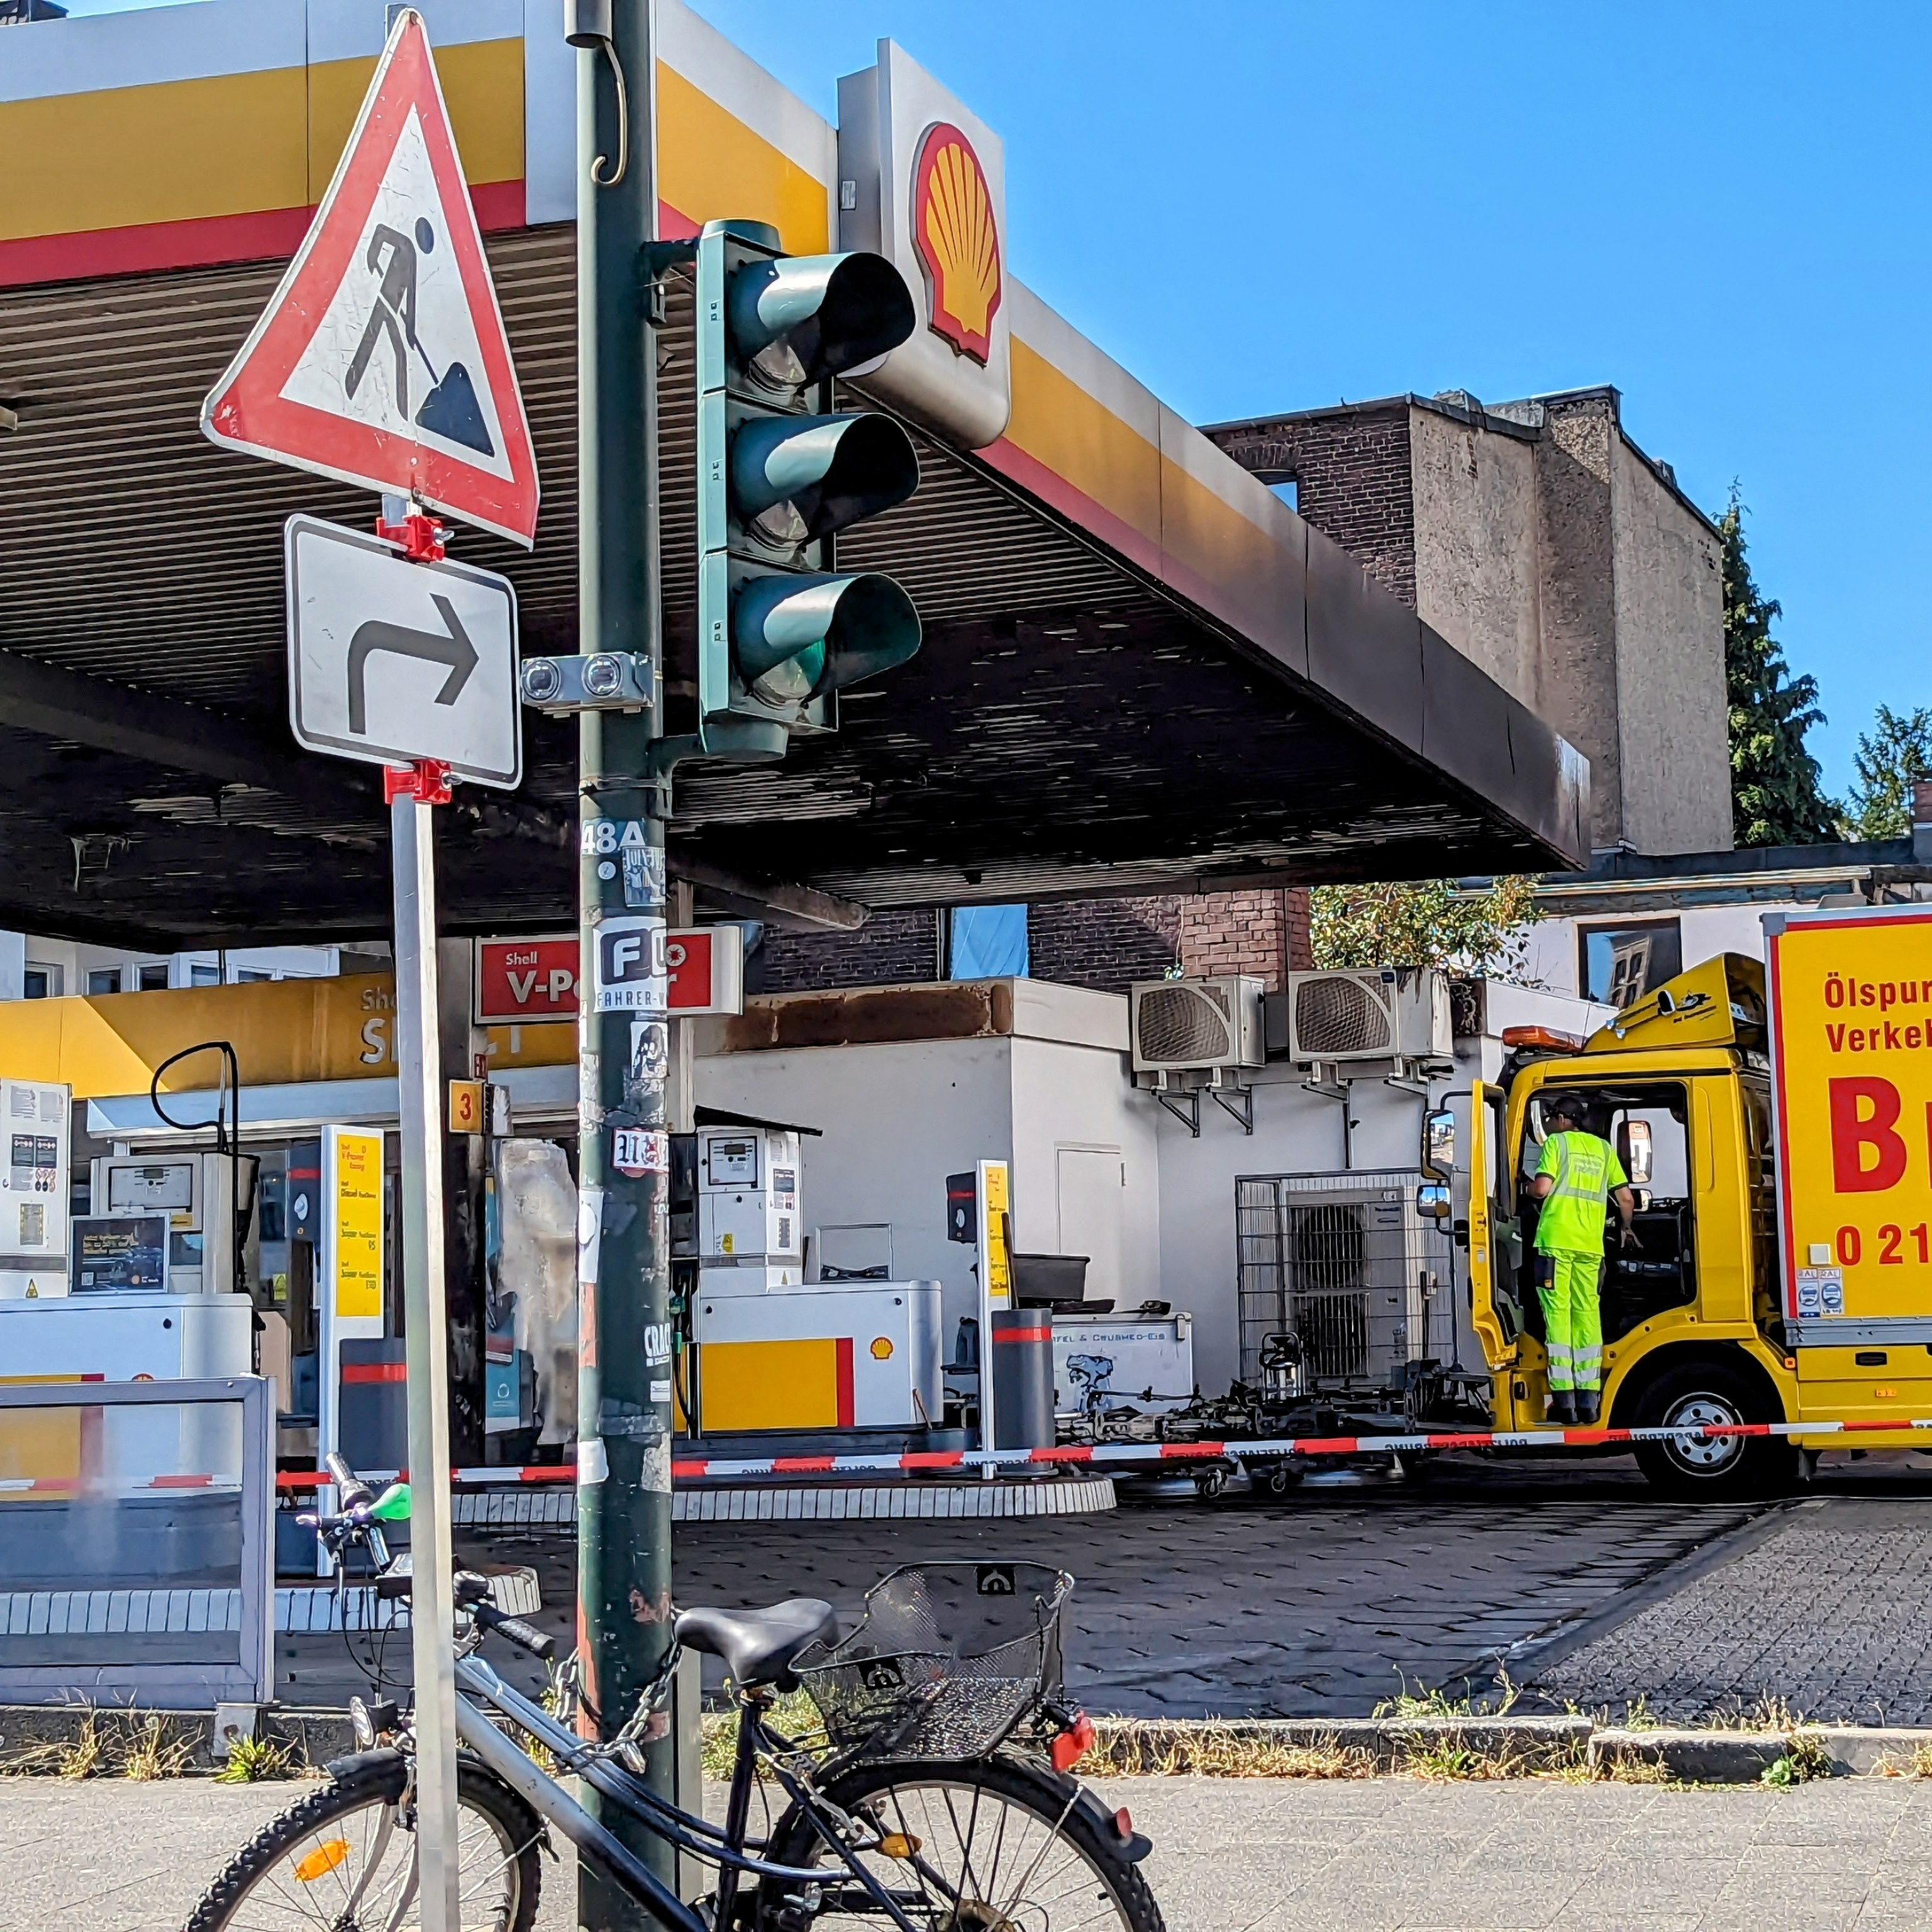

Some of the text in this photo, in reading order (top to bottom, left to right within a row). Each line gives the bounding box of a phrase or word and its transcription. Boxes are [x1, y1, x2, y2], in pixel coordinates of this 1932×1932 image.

[506, 950, 538, 965] Shell
[460, 1092, 472, 1121] 3
[1828, 1076, 1932, 1193] B
[1836, 1225, 1862, 1266] 0
